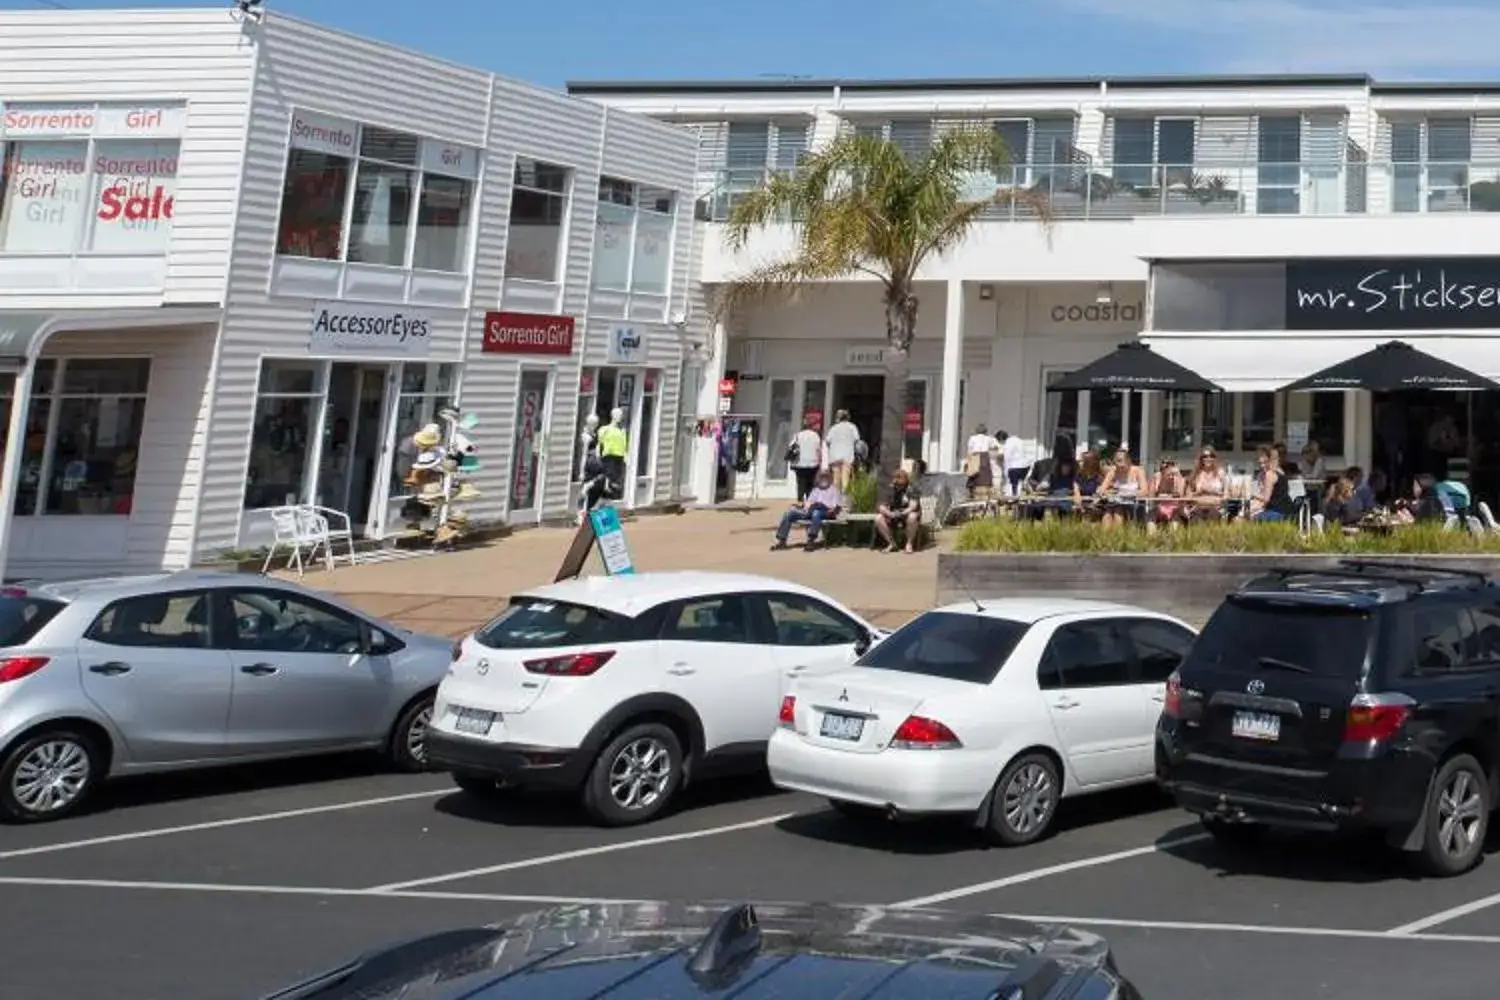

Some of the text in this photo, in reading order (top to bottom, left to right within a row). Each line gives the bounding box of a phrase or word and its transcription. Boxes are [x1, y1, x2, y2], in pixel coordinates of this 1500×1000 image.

[5, 110, 161, 128] Sorrento Girl
[293, 118, 351, 147] Sorrento
[96, 157, 178, 175] Sorrento
[1051, 301, 1143, 322] coastal
[315, 309, 428, 342] AccessorEyes
[489, 320, 569, 347] Sorrento Girl
[515, 392, 537, 500] SALE
